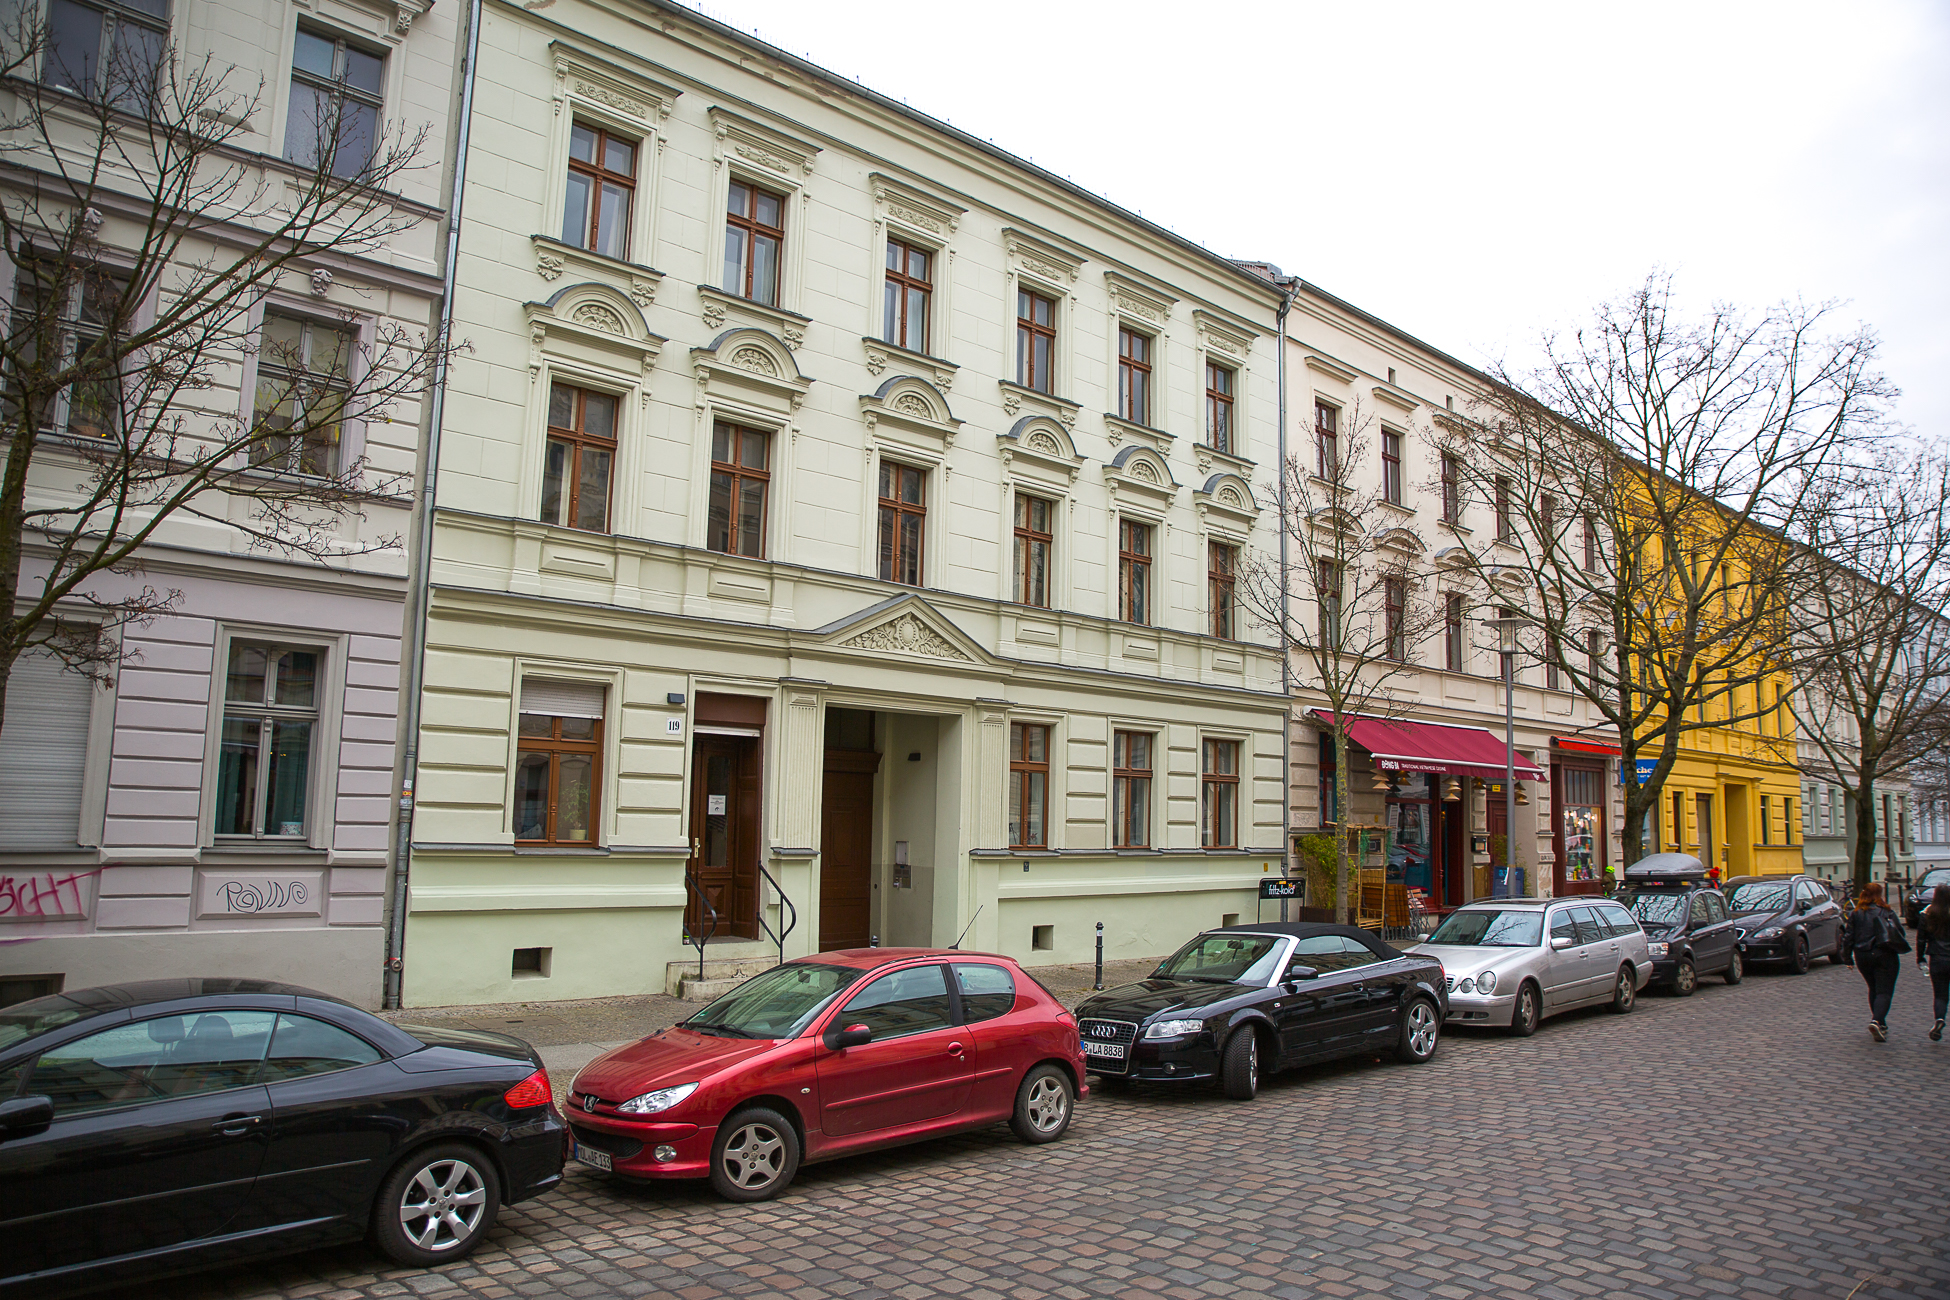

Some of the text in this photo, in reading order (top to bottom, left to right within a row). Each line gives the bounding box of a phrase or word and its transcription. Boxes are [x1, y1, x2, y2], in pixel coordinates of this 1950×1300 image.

[668, 720, 680, 731] 119
[1084, 1043, 1123, 1057] B LA 8838
